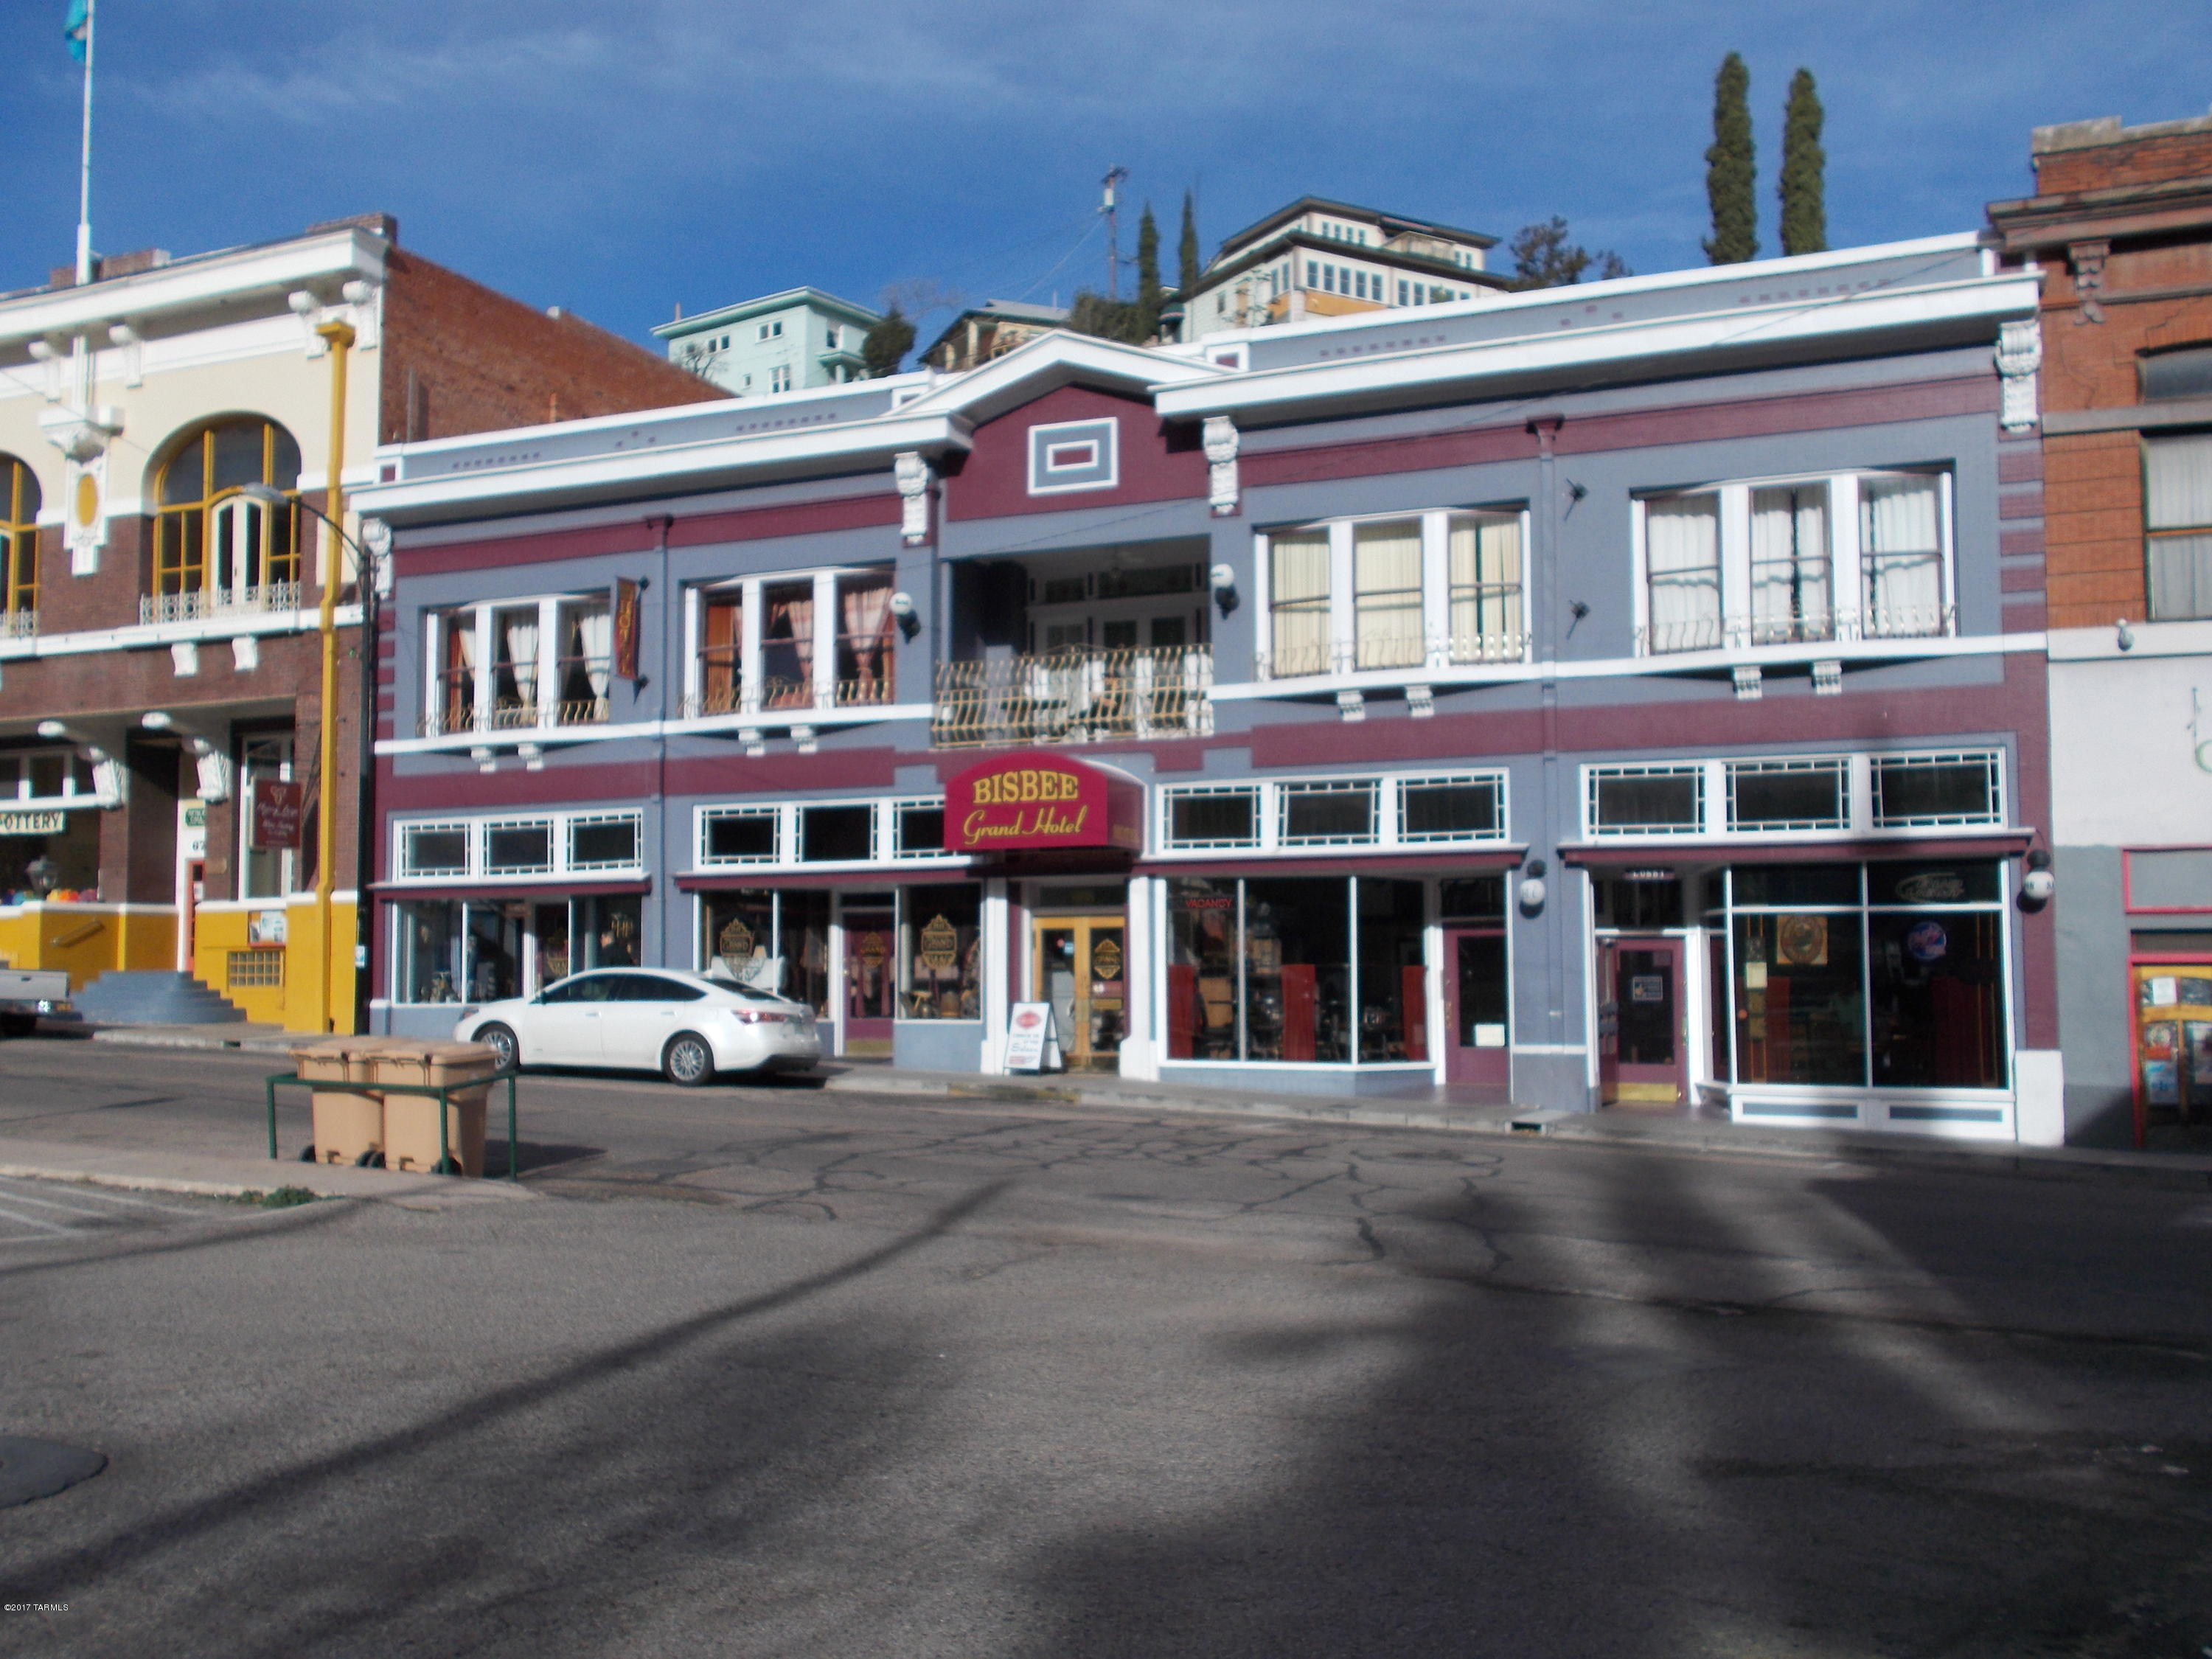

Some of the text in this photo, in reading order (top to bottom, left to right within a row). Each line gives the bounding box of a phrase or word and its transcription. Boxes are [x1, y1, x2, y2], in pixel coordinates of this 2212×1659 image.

[973, 770, 1079, 804] BISBEE
[0, 812, 60, 829] OTTERY
[963, 810, 1023, 846] Grand
[1023, 805, 1088, 835] Hotel
[1186, 898, 1231, 909] VACANCY
